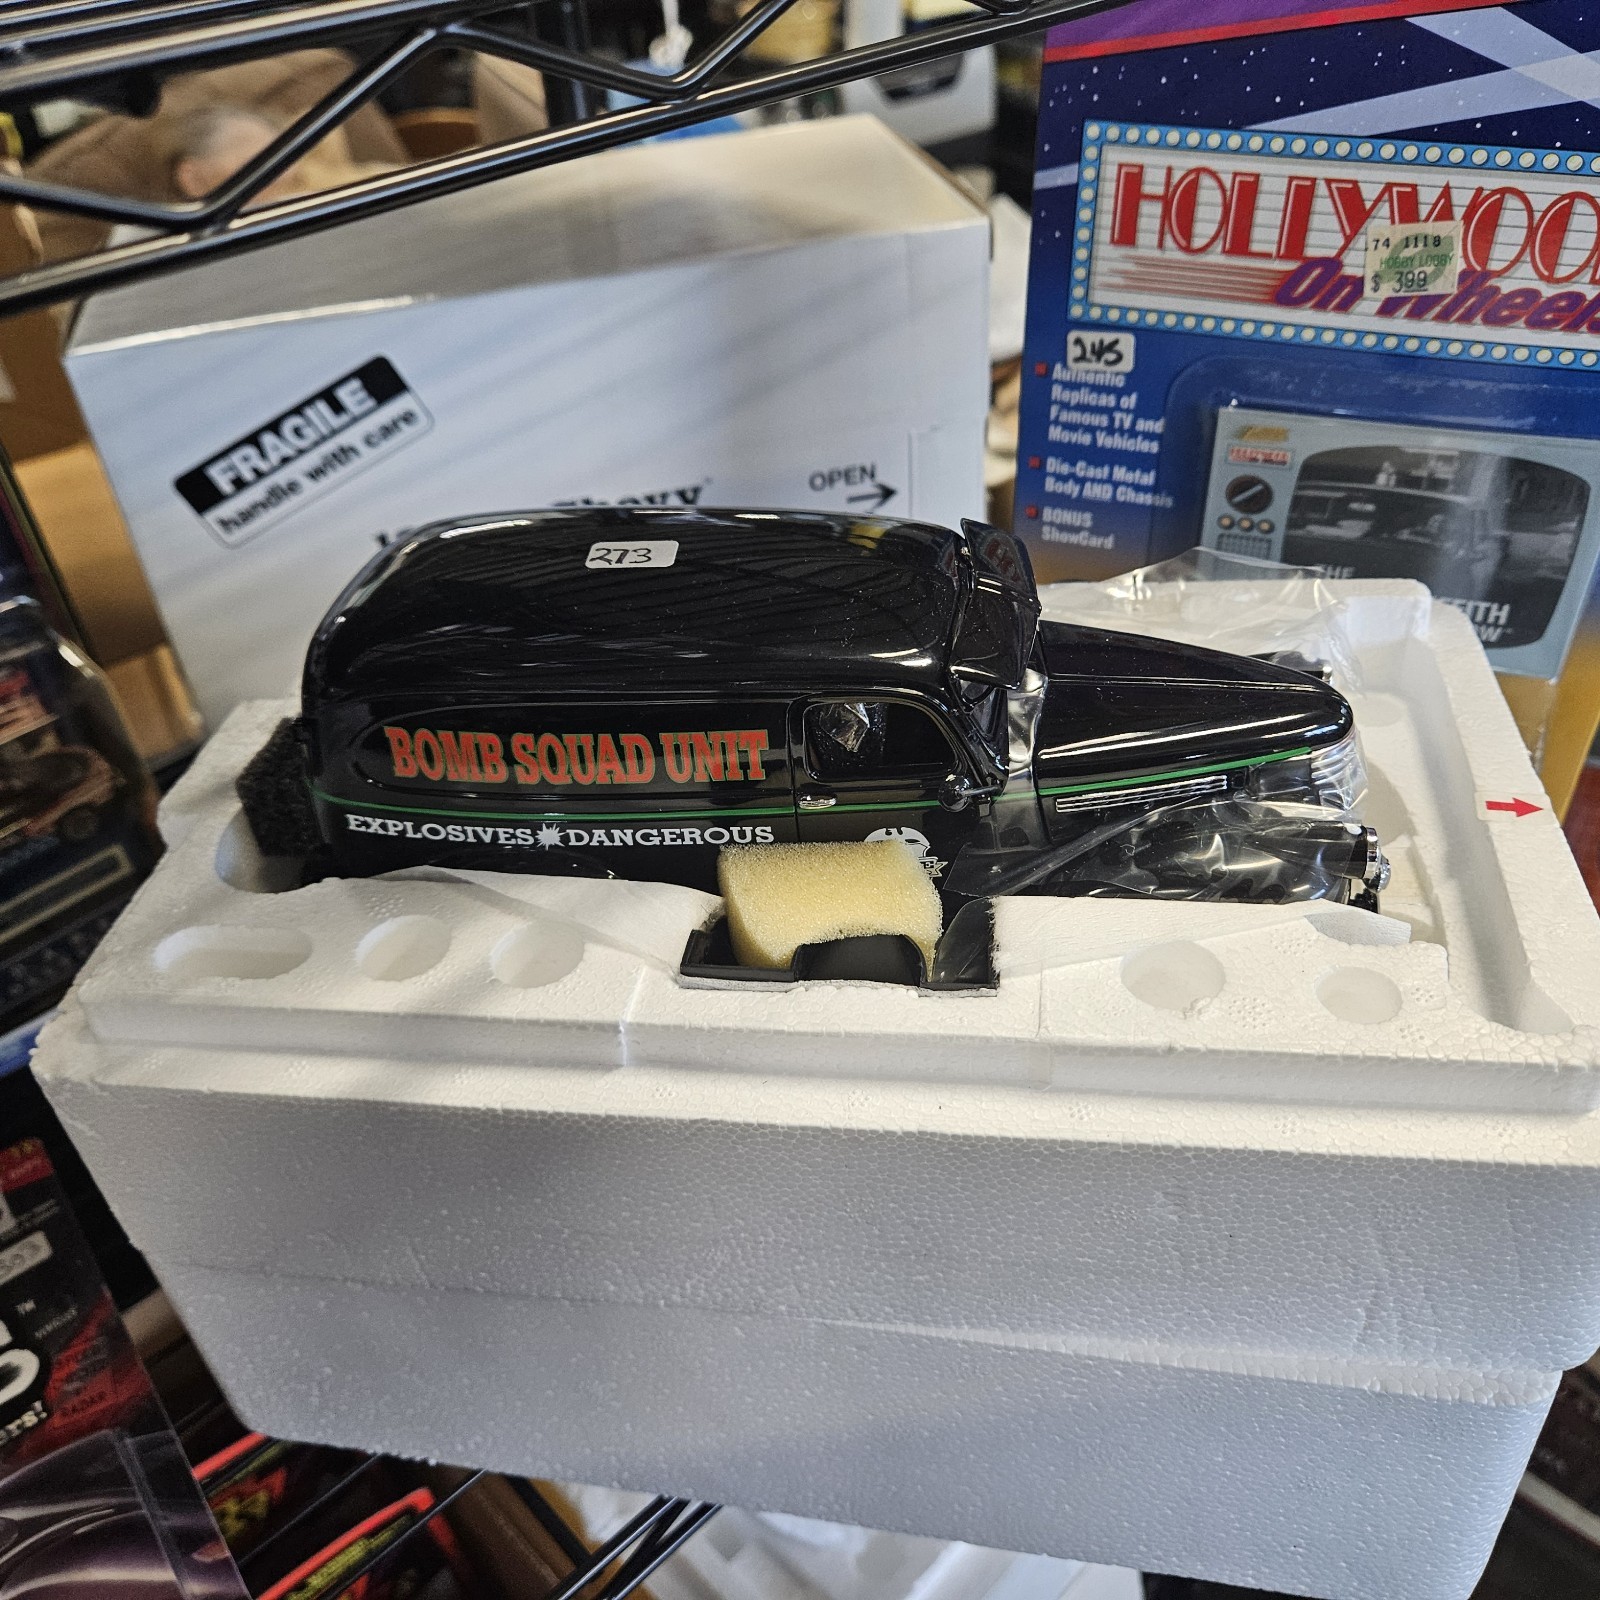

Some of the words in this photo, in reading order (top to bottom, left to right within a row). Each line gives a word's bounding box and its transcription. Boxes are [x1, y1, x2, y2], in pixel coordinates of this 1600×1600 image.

[1109, 163, 1600, 284] HOLLYWOO
[1404, 235, 1442, 249] 1118
[1379, 255, 1416, 270] HOBBY
[1417, 252, 1455, 268] LOBBY
[1273, 256, 1365, 313] On
[1072, 335, 1124, 367] 245
[1051, 361, 1127, 389] Authentic
[1051, 383, 1118, 408] Replicas
[1119, 391, 1138, 411] of
[1049, 403, 1110, 429] Famous
[1112, 409, 1135, 431] TV
[1134, 415, 1166, 435] and
[203, 376, 379, 496] FRAGILE
[1047, 423, 1093, 447] Movie
[1095, 430, 1160, 455] Vehicles
[216, 477, 303, 535] handle
[304, 444, 362, 484] with
[362, 409, 419, 450] care
[808, 462, 877, 493] OPEN
[1045, 455, 1111, 481] Die-Cast
[1112, 463, 1157, 487] Metal
[1044, 474, 1081, 500] Body
[1081, 480, 1115, 503] AND
[1115, 484, 1174, 509] Chassis
[1041, 505, 1094, 529] BONUS
[1040, 523, 1116, 551] ShowCard
[588, 547, 652, 566] 273
[383, 725, 509, 784] BOMB
[511, 732, 656, 786] SQUAD
[658, 728, 770, 784] UNIT
[344, 812, 535, 846] EXPLOSIVES
[565, 825, 775, 847] DANGEROUS
